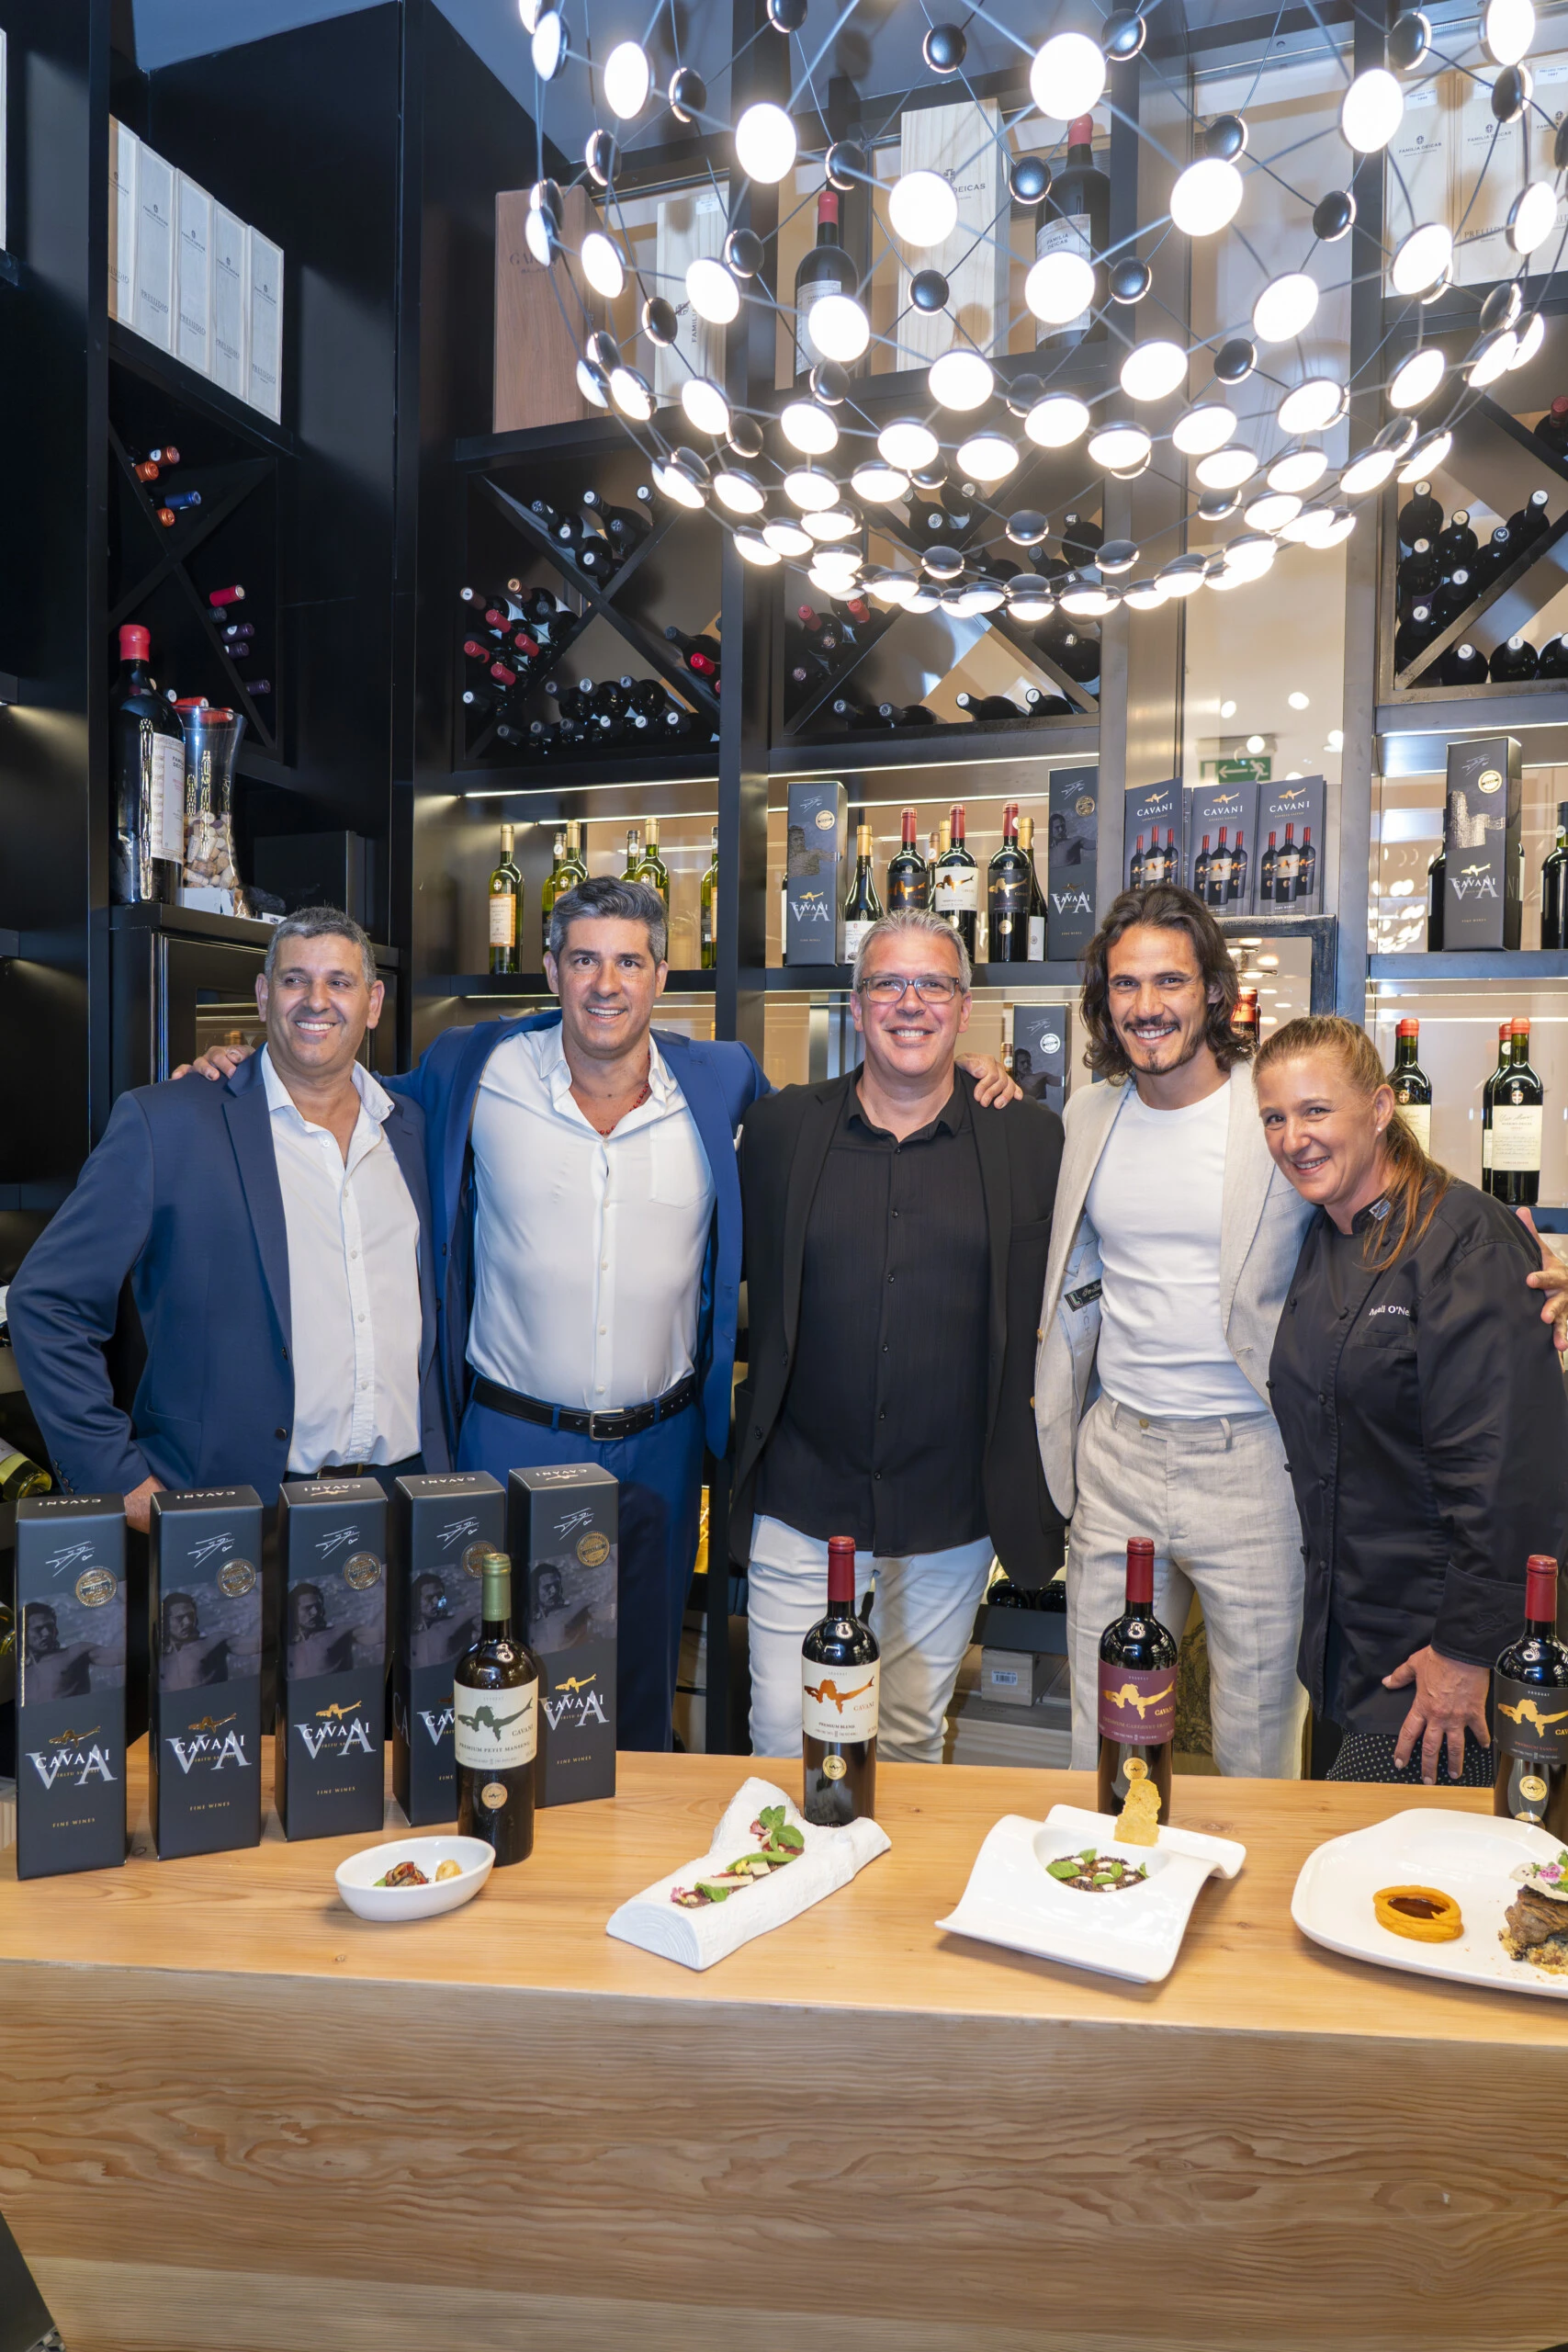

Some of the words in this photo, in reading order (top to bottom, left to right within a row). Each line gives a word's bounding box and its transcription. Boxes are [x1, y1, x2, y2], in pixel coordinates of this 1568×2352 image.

[1398, 145, 1420, 154] FAMILIA
[1046, 232, 1069, 245] FAMILIA
[141, 288, 170, 314] PRELUDIO
[180, 313, 207, 336] PRELUDIO
[215, 337, 241, 360] PRELUDIO
[253, 362, 276, 385] PRELUDIO
[1136, 802, 1173, 817] CAVANI
[1203, 805, 1244, 816] CAVANI
[1269, 800, 1311, 813] CAVANI
[1453, 877, 1496, 888] CAVANI
[1054, 894, 1090, 903] CAVANI
[793, 903, 829, 911] CAVANI
[543, 1693, 604, 1712] CAVANI
[853, 1702, 874, 1712] CAVANI
[302, 1722, 370, 1740] CAVANI
[512, 1724, 534, 1737] CAVANI
[818, 1721, 840, 1729] PREMIUM
[175, 1734, 245, 1755] CAVANI
[458, 1742, 482, 1753] PREMIUM
[36, 1748, 110, 1770] CAVANI
[334, 1785, 356, 1793] WINES
[72, 1817, 96, 1826] WINES
